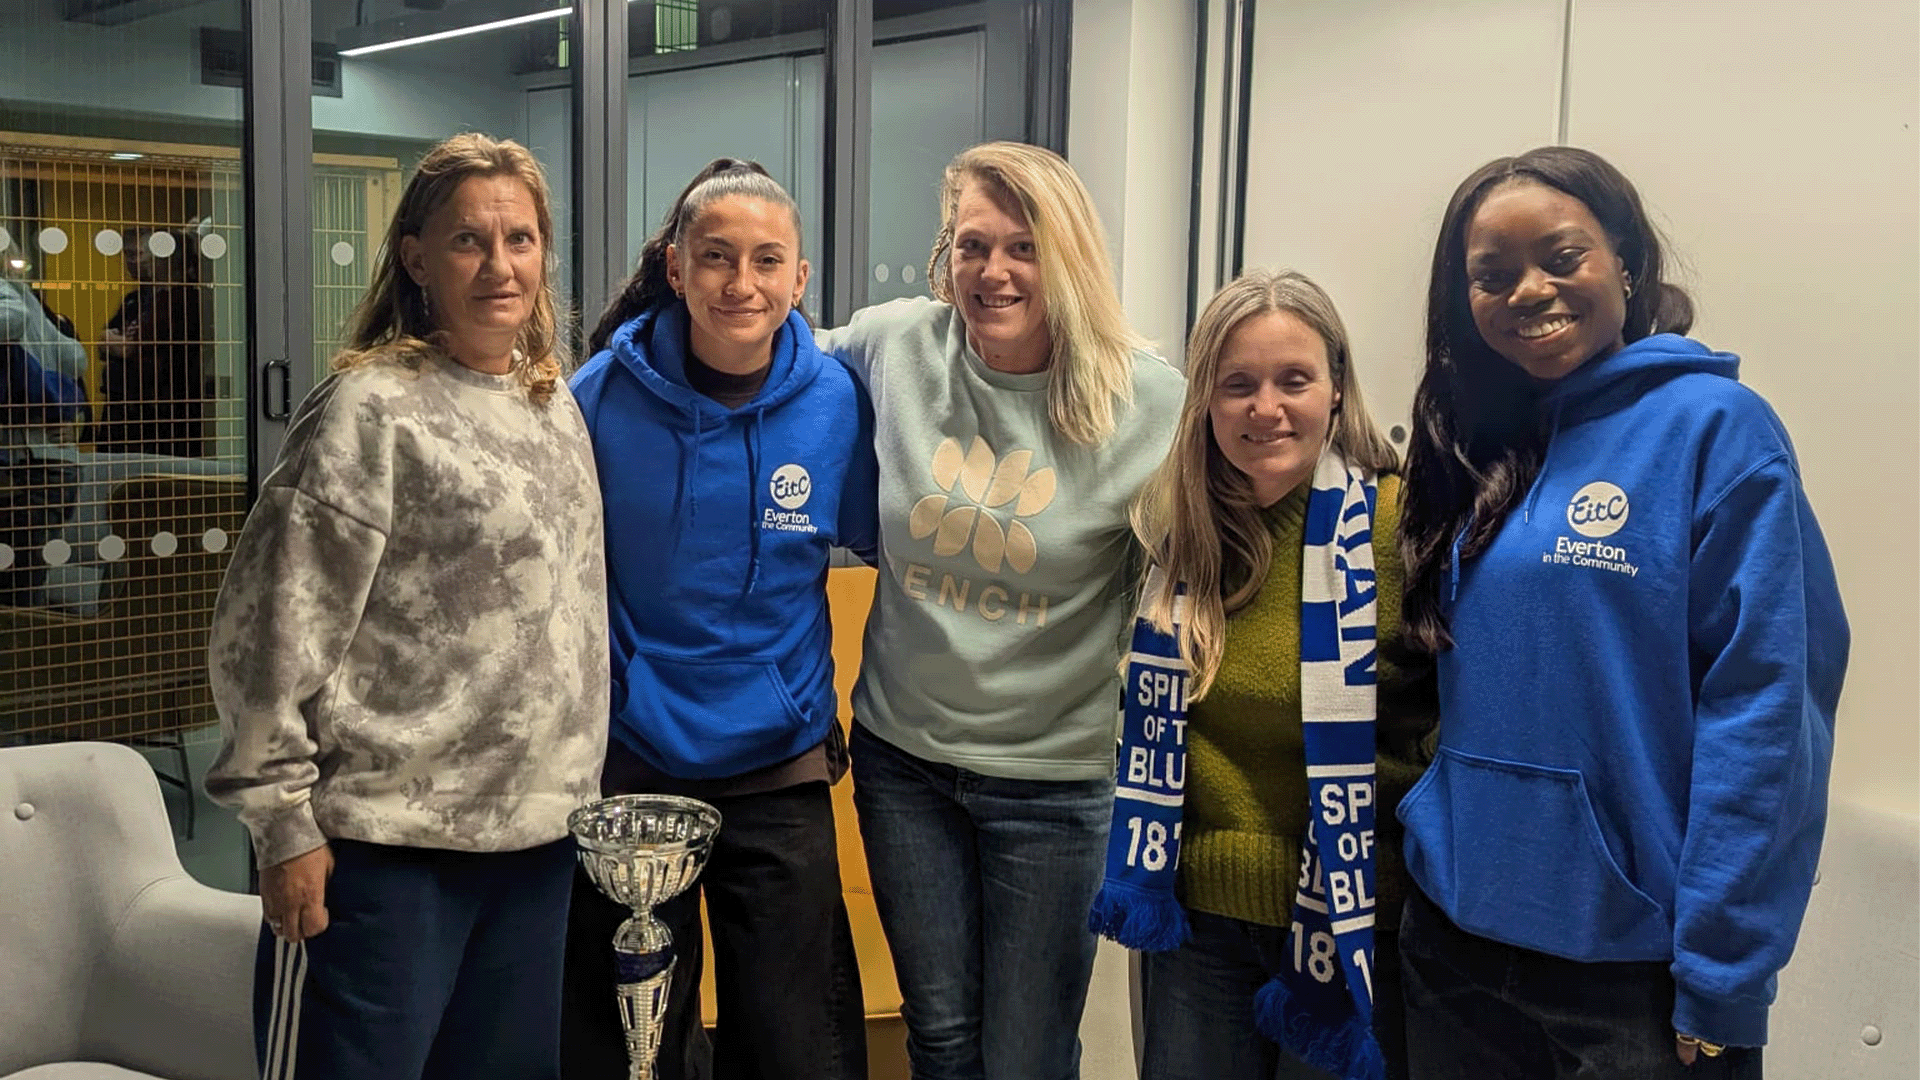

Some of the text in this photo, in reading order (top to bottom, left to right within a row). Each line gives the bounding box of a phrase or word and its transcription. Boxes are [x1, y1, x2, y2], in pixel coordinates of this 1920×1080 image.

[770, 475, 809, 499] EitC
[764, 508, 810, 525] Everton
[1570, 495, 1628, 525] EitC
[775, 521, 819, 534] Community
[1556, 536, 1626, 561] Everton
[1542, 552, 1639, 577] in the Community
[1143, 715, 1167, 743] OF
[1128, 746, 1187, 790] BLU
[1320, 782, 1377, 825] SP
[1338, 829, 1374, 861] OF
[1329, 868, 1376, 914] BL
[1291, 921, 1336, 983] 18
